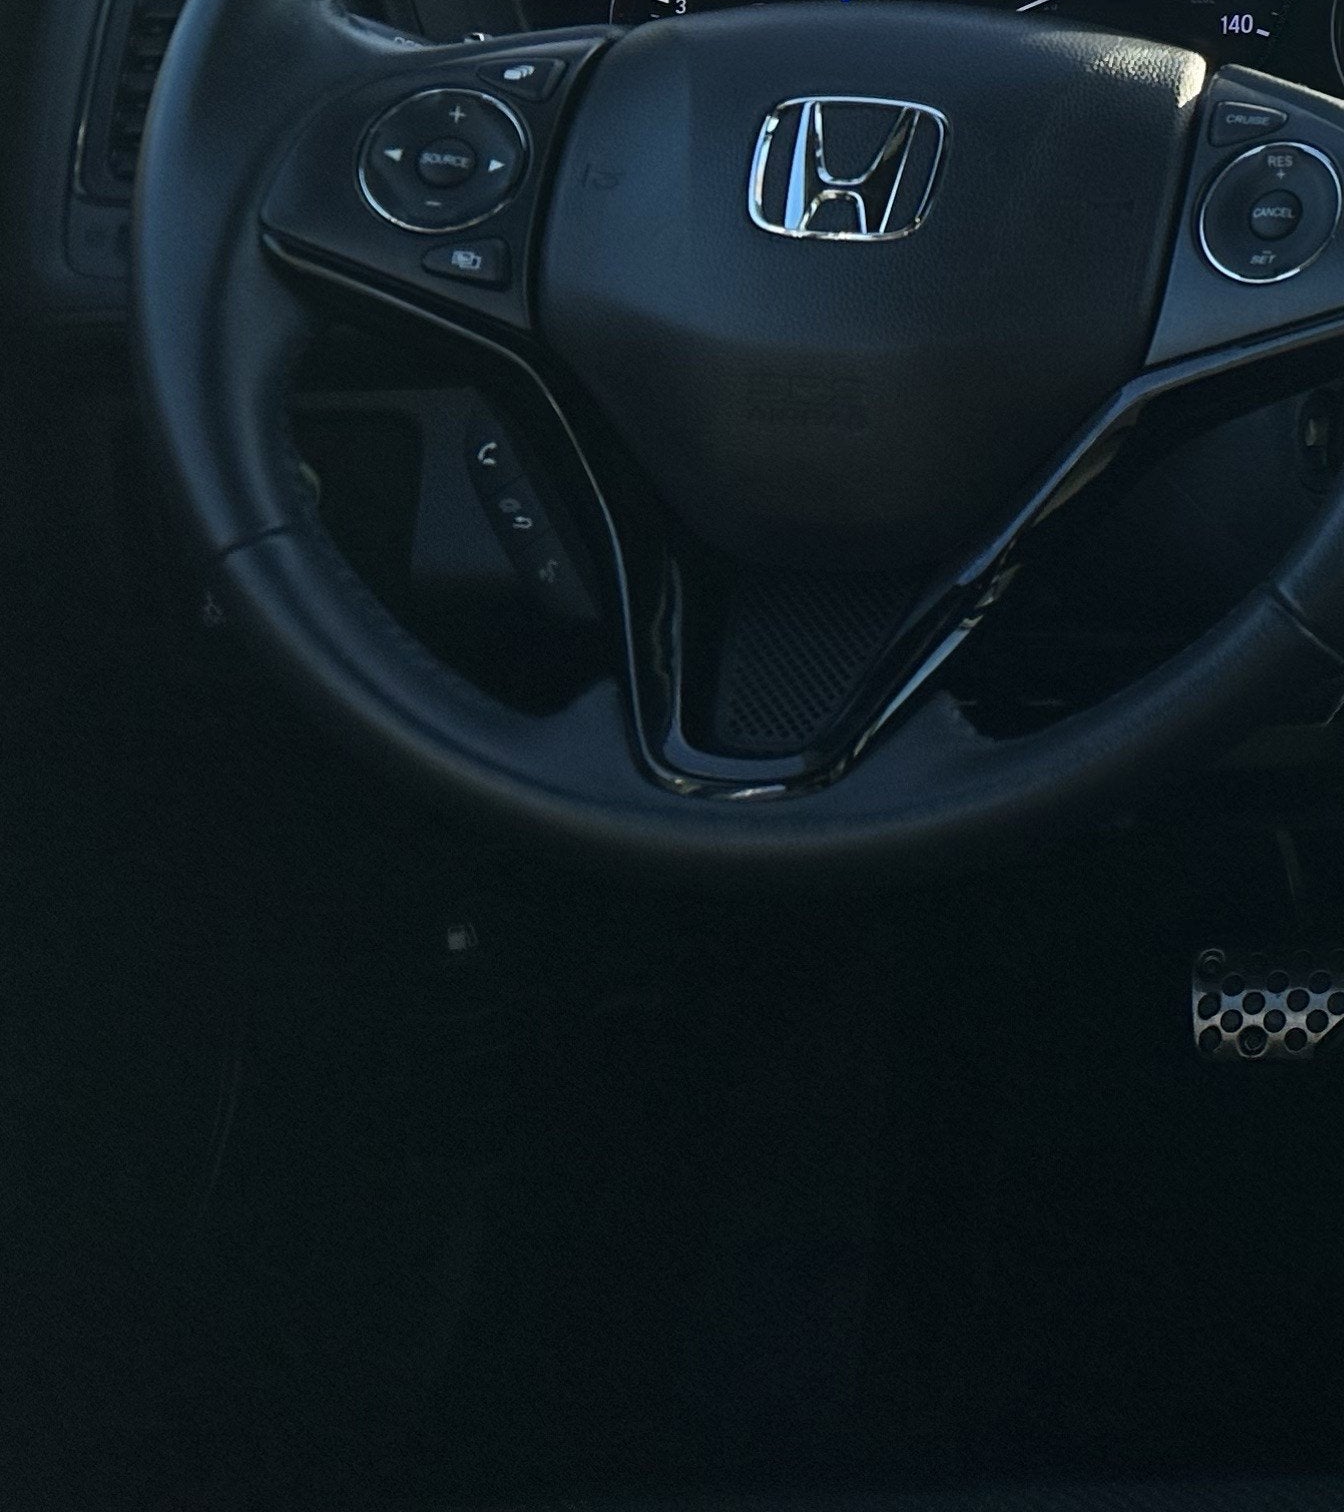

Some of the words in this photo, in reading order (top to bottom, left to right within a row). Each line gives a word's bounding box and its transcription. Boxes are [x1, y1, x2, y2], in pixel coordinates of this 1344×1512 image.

[675, 0, 687, 14] 3
[1220, 15, 1253, 34] 140
[1226, 114, 1270, 125] CRUISE
[422, 152, 468, 168] SOURCE
[1267, 155, 1293, 167] RES
[1253, 208, 1294, 219] CANCEL
[1250, 254, 1276, 265] SET
